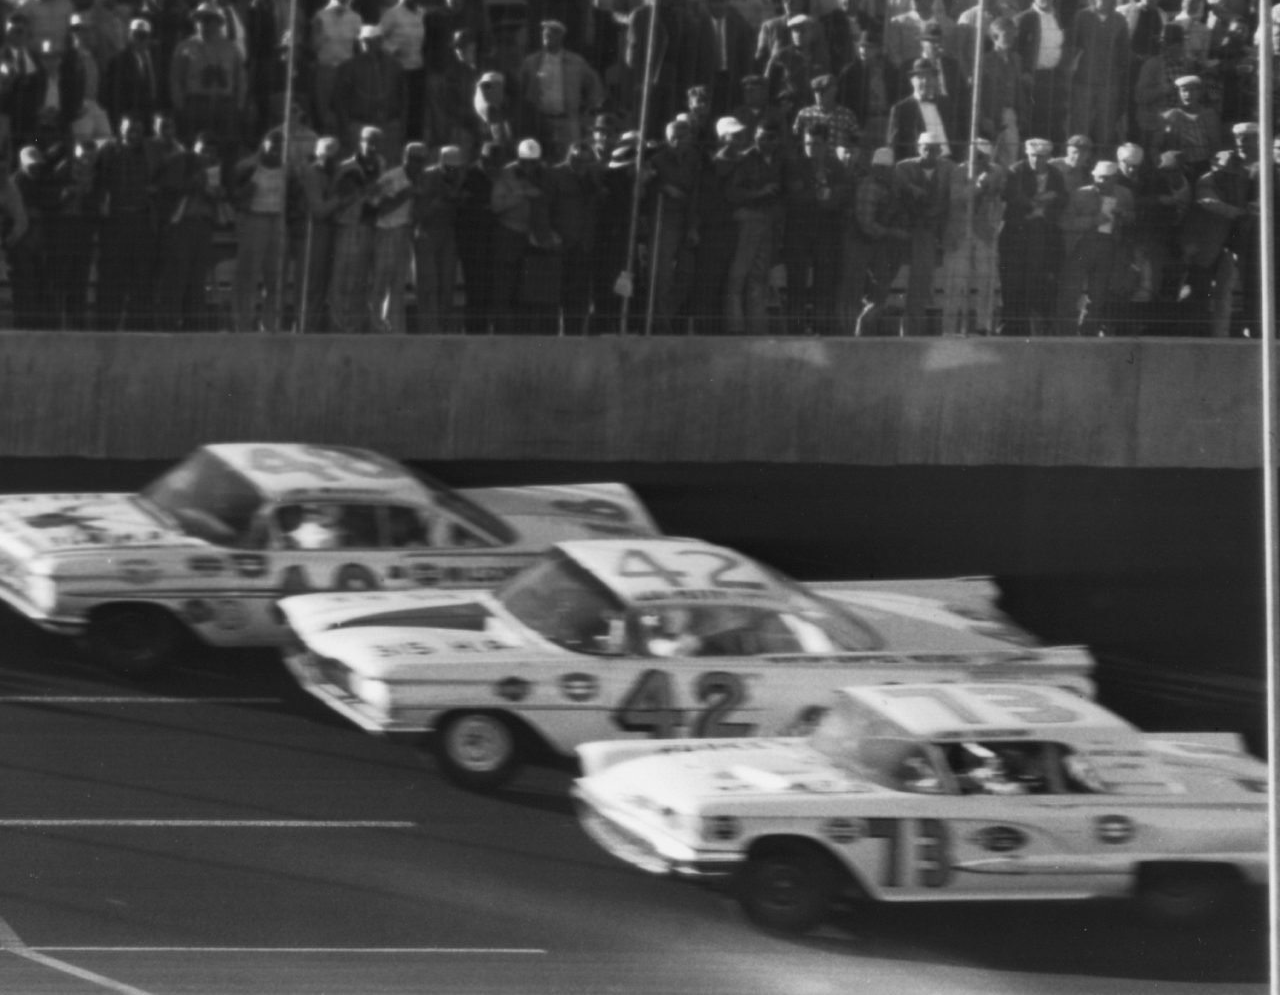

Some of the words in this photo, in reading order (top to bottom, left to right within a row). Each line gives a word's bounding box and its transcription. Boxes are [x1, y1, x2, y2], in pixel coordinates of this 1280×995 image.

[618, 549, 769, 590] 42
[612, 669, 758, 738] 42
[877, 687, 1084, 724] 73
[866, 817, 955, 888] 73
